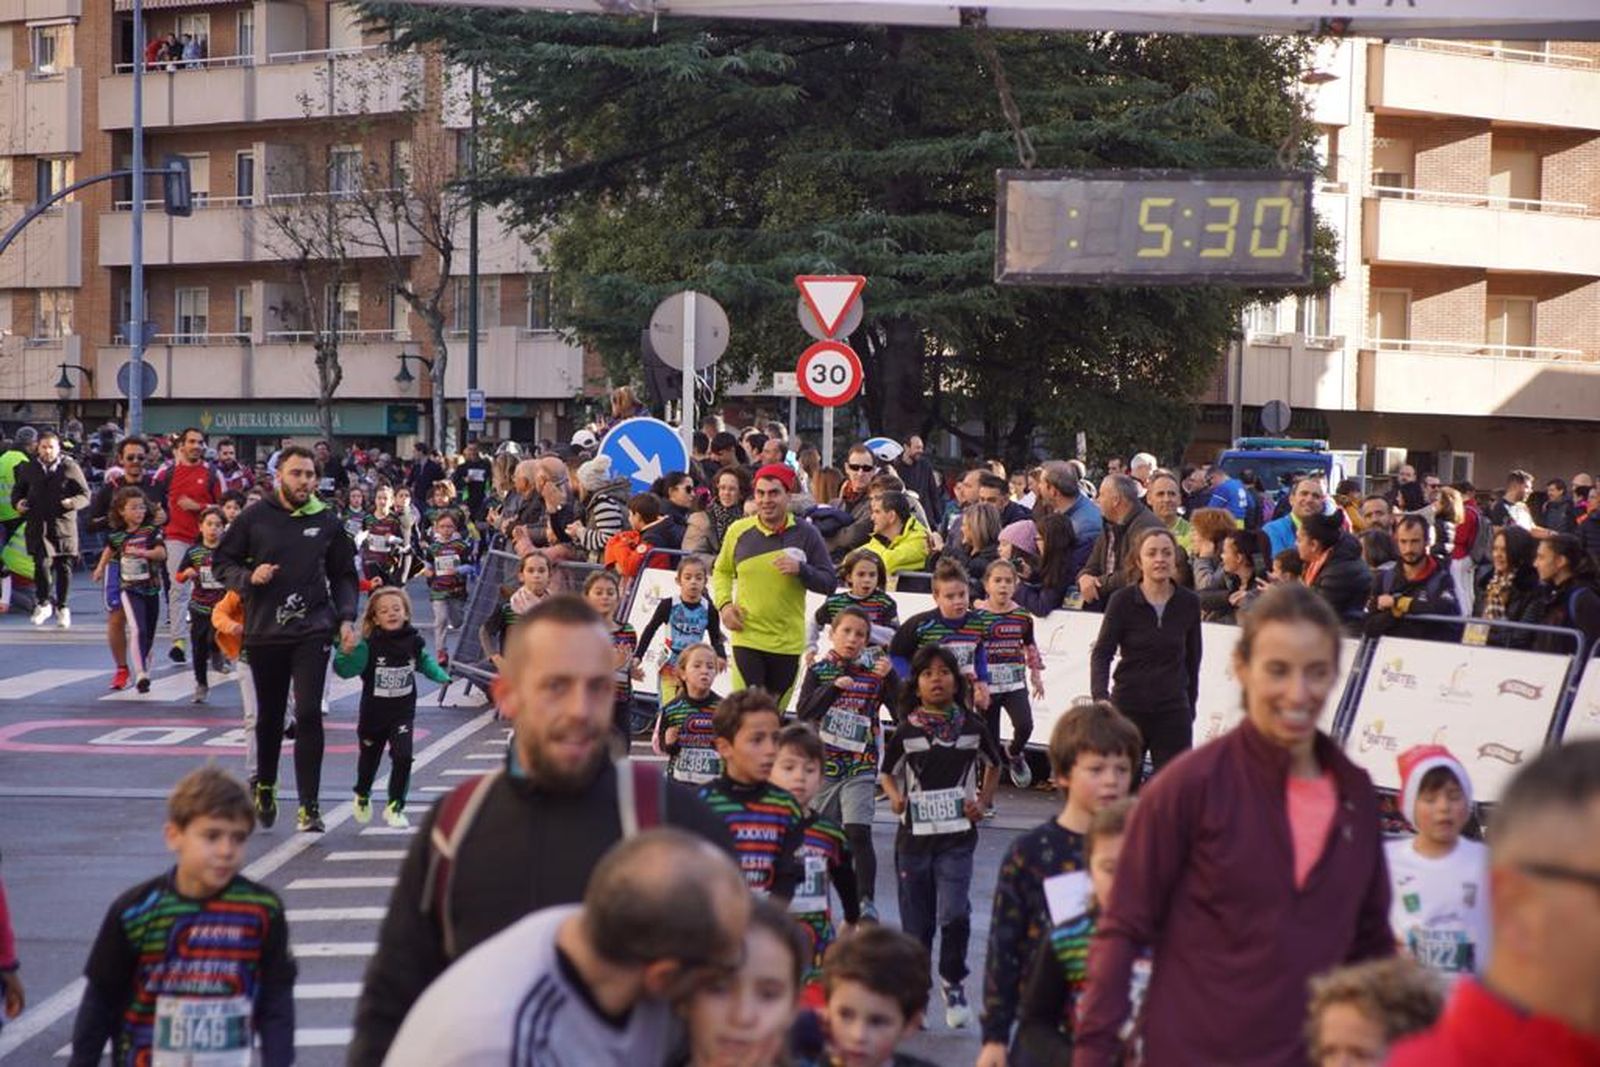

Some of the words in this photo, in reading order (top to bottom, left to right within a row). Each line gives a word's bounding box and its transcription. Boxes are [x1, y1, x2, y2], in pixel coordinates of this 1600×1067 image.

[812, 364, 846, 385] 30
[215, 412, 238, 430] CAJA
[239, 412, 268, 427] RURAL
[269, 412, 280, 427] DE
[828, 716, 858, 739] 6391
[679, 756, 711, 772] 6384
[918, 799, 957, 820] 6068
[168, 1017, 228, 1048] 6146
